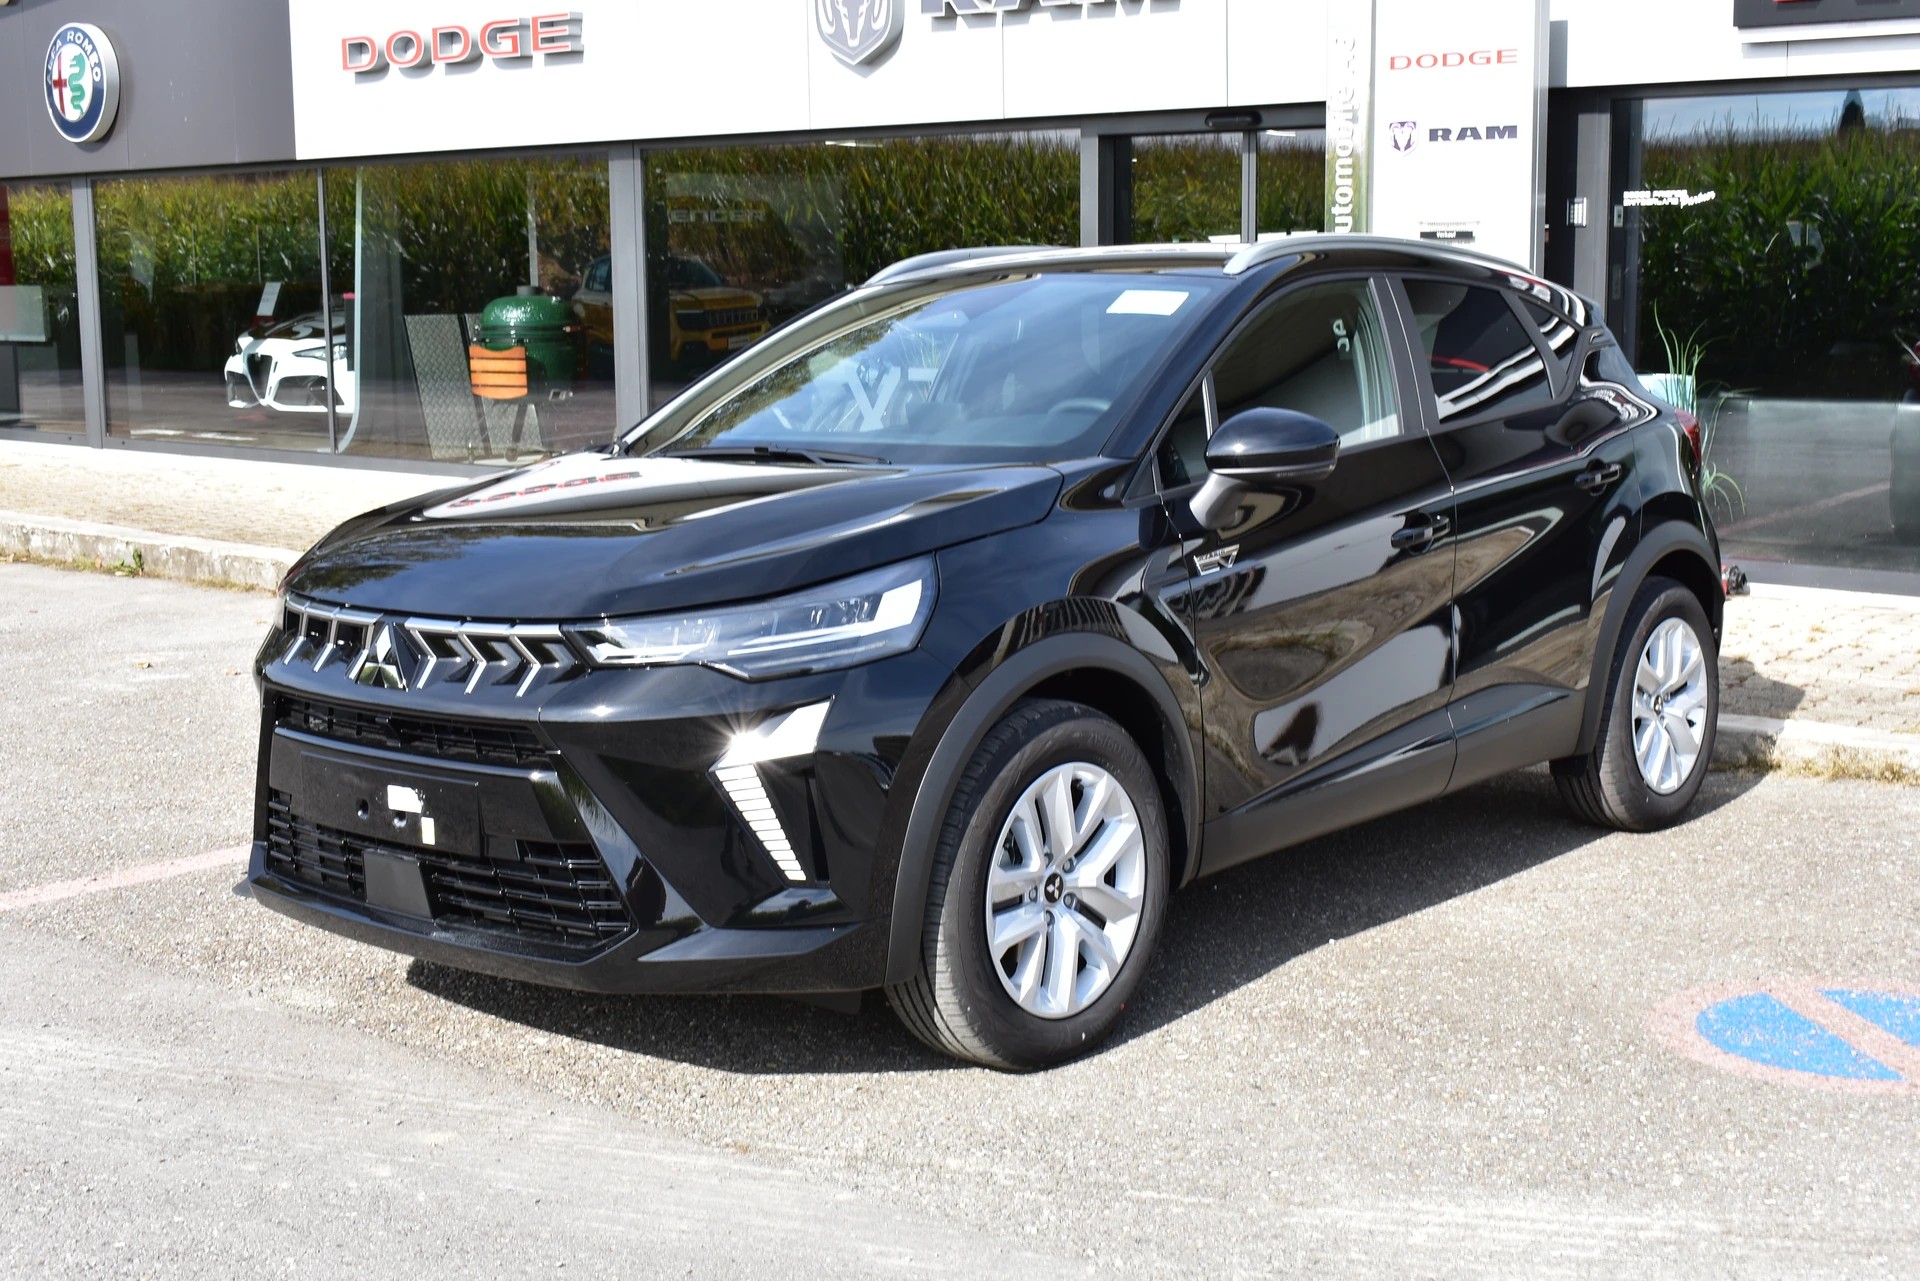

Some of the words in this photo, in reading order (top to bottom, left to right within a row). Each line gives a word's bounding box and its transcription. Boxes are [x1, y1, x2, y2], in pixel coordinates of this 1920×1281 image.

[66, 30, 101, 82] ROMEO
[341, 12, 576, 73] DODGE
[1389, 48, 1518, 70] DODGE
[1428, 124, 1518, 142] RAM
